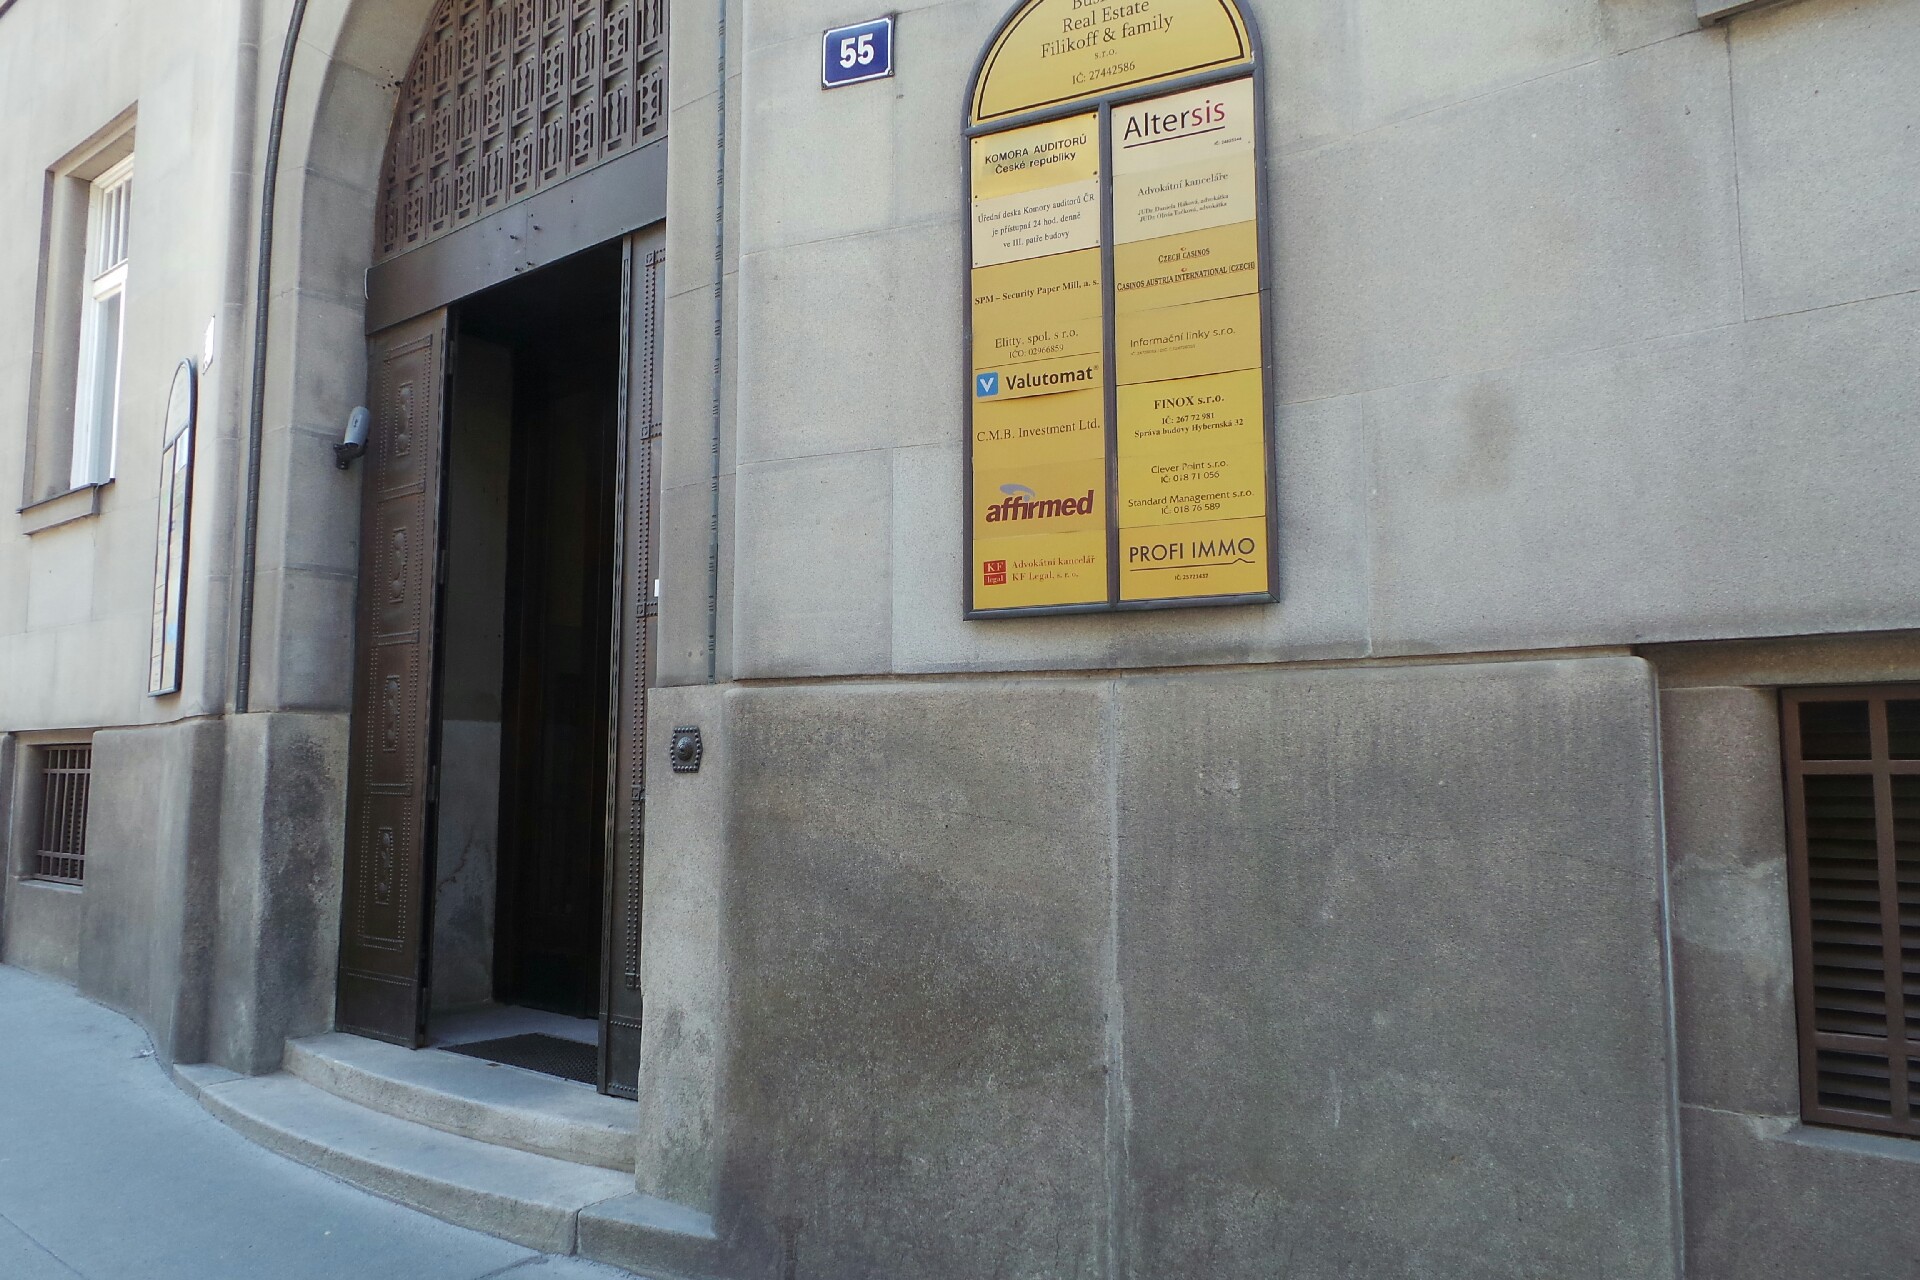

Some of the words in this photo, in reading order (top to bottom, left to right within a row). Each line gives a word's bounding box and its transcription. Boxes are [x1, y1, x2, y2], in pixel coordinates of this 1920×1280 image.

[1062, 10, 1096, 33] Real
[1102, 1, 1149, 22] Estate
[1041, 30, 1099, 58] Filikoff
[1102, 28, 1116, 42] &
[1121, 13, 1173, 38] family
[840, 33, 874, 69] 55
[1094, 49, 1117, 59] s.r.o.
[1089, 61, 1136, 80] 27442586
[1123, 100, 1225, 141] Altersis
[985, 148, 1029, 165] KOMORA
[995, 161, 1026, 174] České
[1029, 151, 1076, 168] republiky
[1137, 180, 1183, 196] Advokátní
[1184, 173, 1228, 188] kanceláře
[977, 212, 1001, 223] Úřední
[1003, 209, 1021, 219] deska
[1023, 204, 1051, 215] Komory
[1083, 193, 1095, 203] ČR
[992, 228, 999, 237] je
[1000, 223, 1031, 236] přístupní
[1033, 220, 1041, 228] 24
[1043, 217, 1058, 226] hod.
[1060, 212, 1081, 222] denně
[1044, 231, 1070, 240] budovy
[1158, 252, 1181, 263] CZECH
[1182, 248, 1210, 259] CASINOS
[1117, 280, 1145, 291] CASINOS
[1146, 275, 1174, 287] AUSTRIA
[1174, 266, 1228, 282] INTERNATIONAL
[974, 294, 994, 305] SPM
[1002, 289, 1035, 301] Security
[1037, 285, 1060, 296] Paper
[1062, 281, 1082, 290] Mill,
[1027, 331, 1051, 345] spol.
[1053, 332, 1059, 340] s
[1062, 329, 1079, 339] r.o.
[1130, 332, 1184, 348] Informační
[1186, 329, 1210, 341] linky
[1212, 327, 1236, 336] s.r.o.
[1154, 396, 1195, 410] FINOX
[1197, 394, 1225, 405] s.r.o.
[1176, 414, 1189, 423] 267
[1191, 413, 1200, 421] 72
[1202, 412, 1215, 420] 981
[976, 428, 1015, 442] C.M.B.
[1018, 422, 1076, 439] Investment
[1079, 417, 1101, 431] Ltd.
[1134, 427, 1161, 439] Správa
[1162, 425, 1190, 435] budovy
[1192, 419, 1233, 433] Hybernská
[1151, 465, 1179, 474] Clever
[1182, 460, 1204, 471] Point
[1207, 460, 1229, 469] s.r.o.
[1191, 471, 1201, 480] 71
[1203, 470, 1220, 480] 056
[985, 490, 1094, 522] affirmed
[1128, 496, 1167, 507] Standard
[1169, 490, 1230, 504] Management
[1232, 489, 1255, 498] s.r.o.
[1173, 505, 1190, 514] 018
[1192, 504, 1203, 512] 76
[1204, 502, 1221, 511] 589
[1130, 542, 1184, 563] PROFI
[1192, 537, 1256, 559] IMMO
[987, 561, 1004, 573] KF
[1012, 558, 1056, 569] Advokátní
[1058, 555, 1096, 565] kancelář
[987, 574, 1004, 584] legal
[1012, 573, 1027, 581] KF
